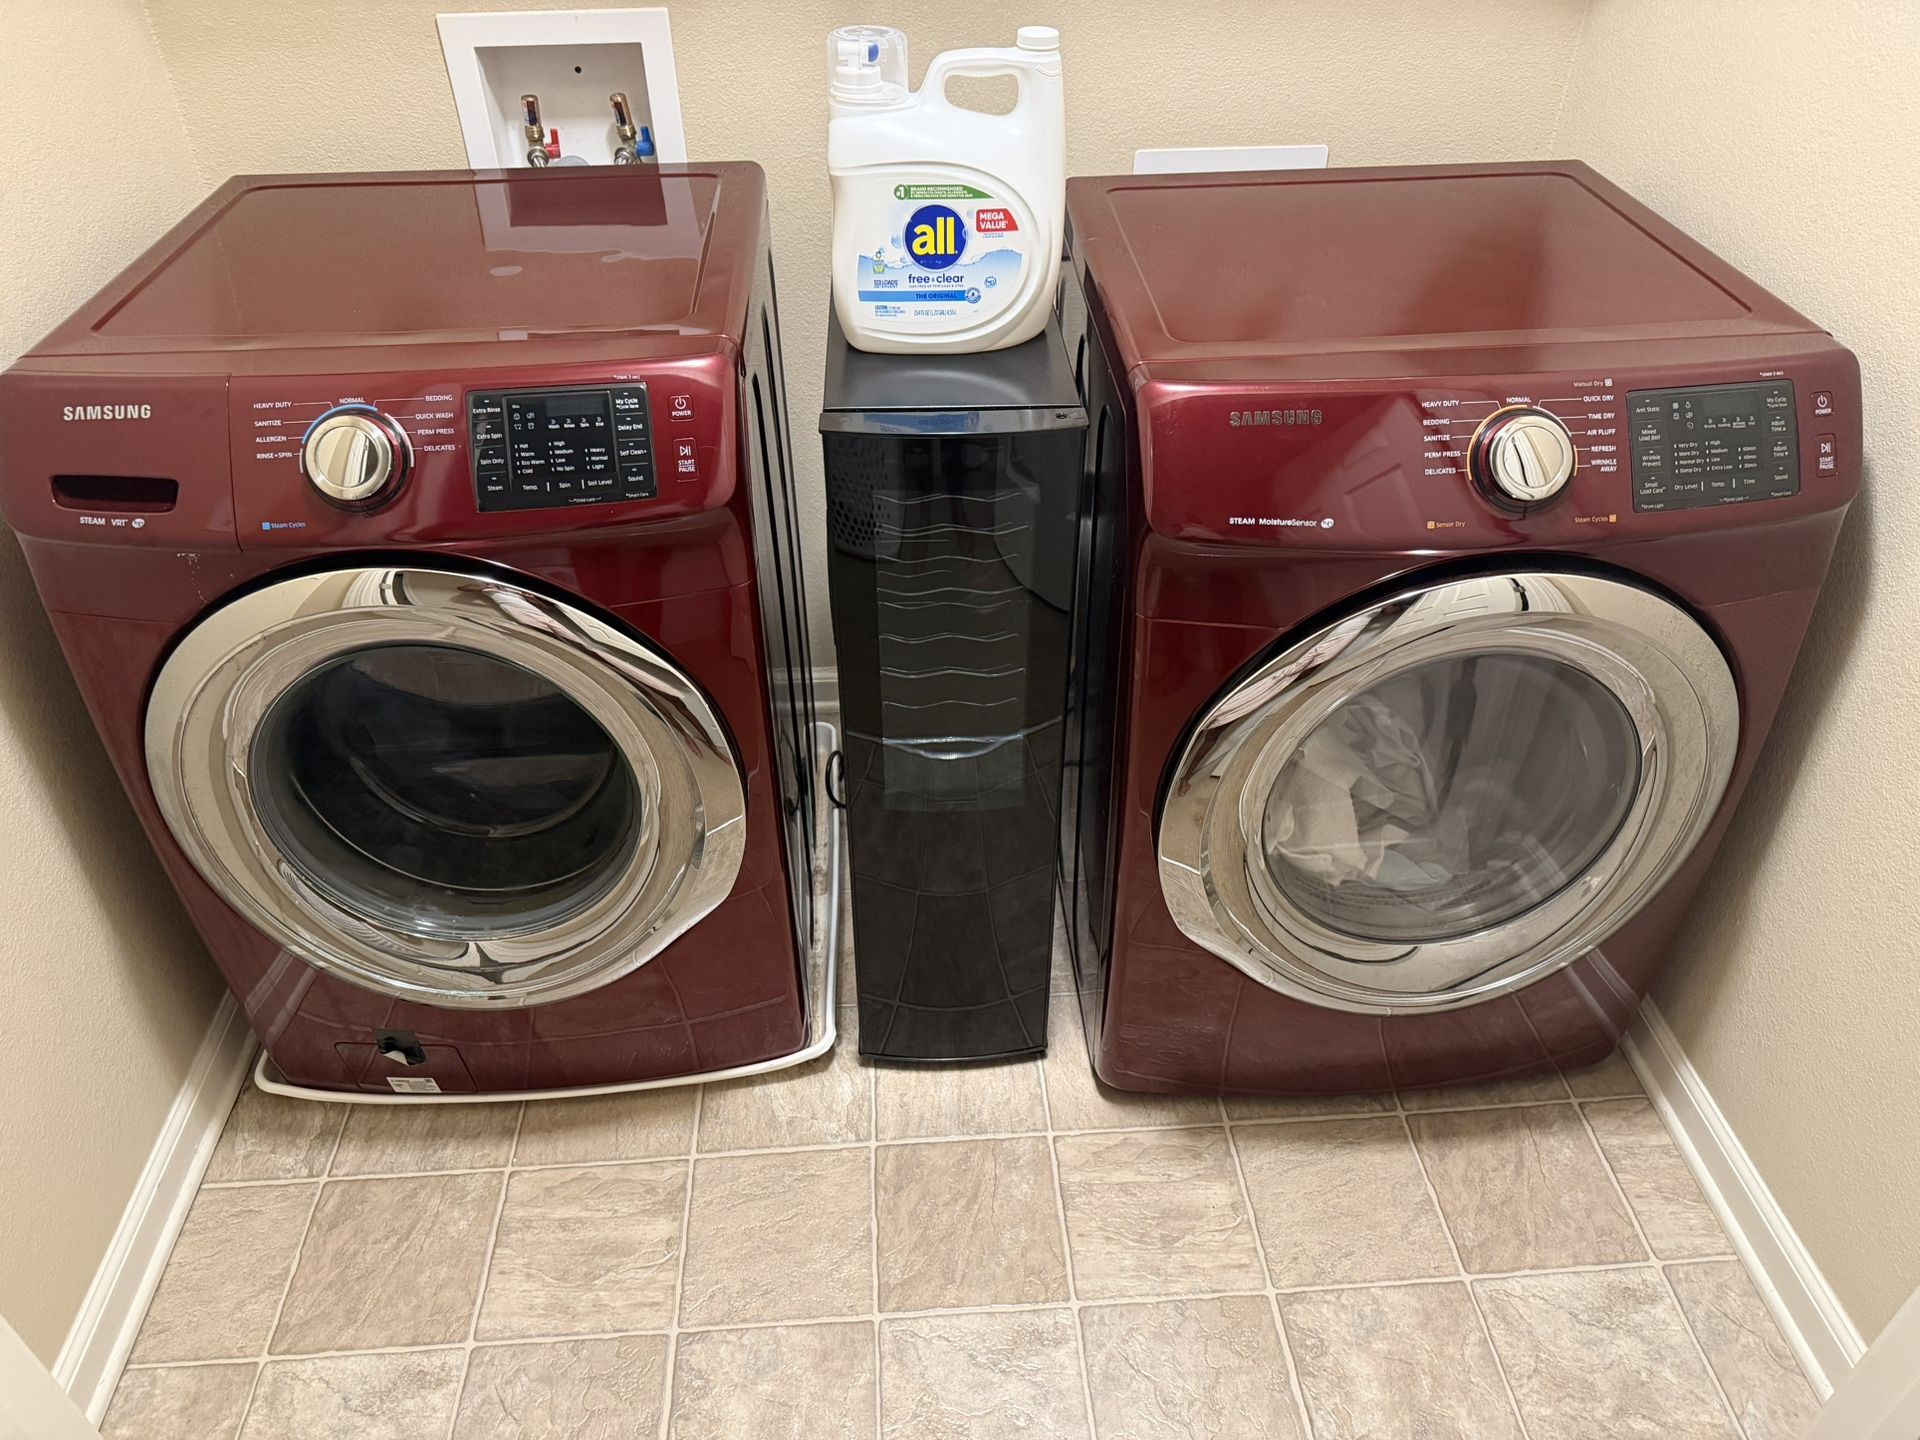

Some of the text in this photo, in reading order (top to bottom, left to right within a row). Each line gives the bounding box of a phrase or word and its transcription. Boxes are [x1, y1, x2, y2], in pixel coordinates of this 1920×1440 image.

[979, 211, 1004, 220] MEGA
[912, 216, 955, 255] all
[908, 273, 964, 284] free clear
[63, 404, 152, 421] SAMSUNG
[1230, 410, 1322, 428] SAMSUNG
[1425, 468, 1456, 476] DELICATES
[80, 516, 106, 525] STEAM
[1258, 518, 1317, 527] MoistureSensor
[1455, 520, 1466, 528] Dry
[1575, 516, 1590, 524] Steam
